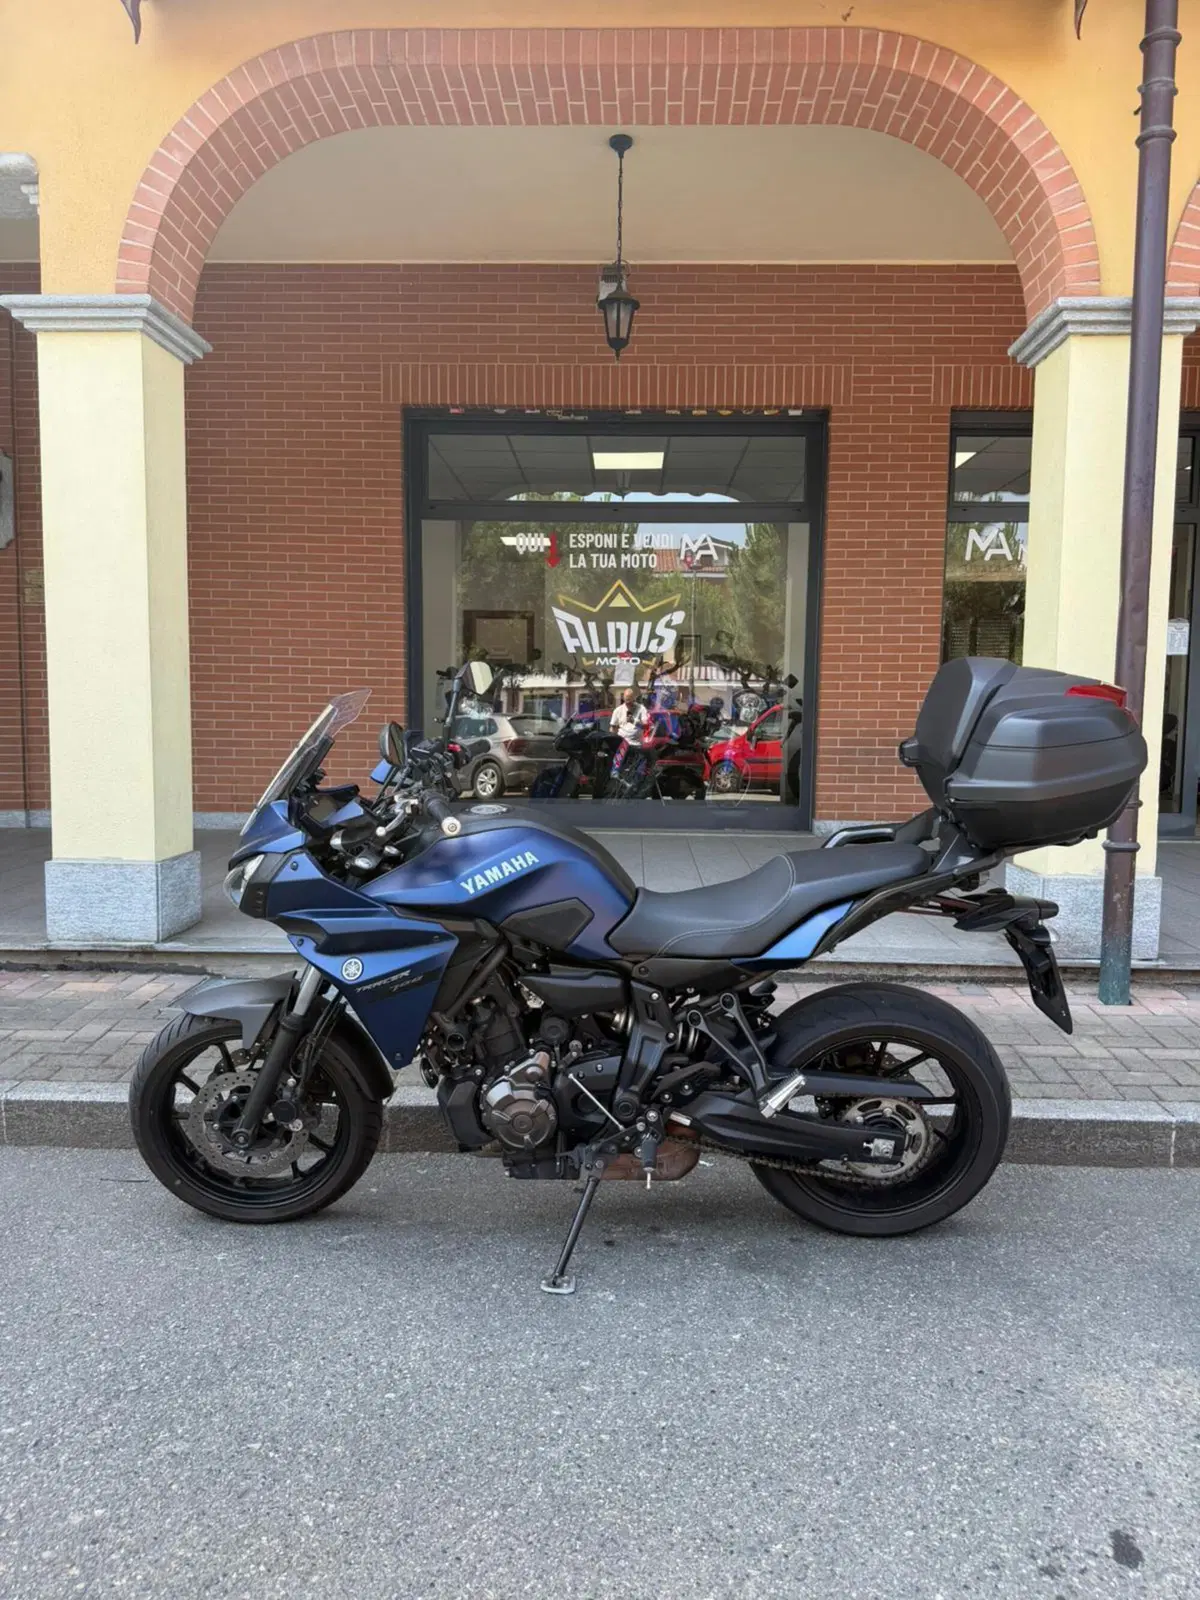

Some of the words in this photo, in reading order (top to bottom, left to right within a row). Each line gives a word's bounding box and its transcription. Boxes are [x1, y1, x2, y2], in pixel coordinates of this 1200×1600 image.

[515, 532, 545, 555] QUI
[569, 533, 618, 549] ESPONI
[621, 533, 630, 549] E
[634, 533, 674, 549] VENDI
[569, 553, 587, 569] LA
[591, 553, 617, 569] TUA
[620, 553, 657, 569] MOTO
[551, 606, 686, 654] ALDUS
[595, 657, 641, 667] MOTO
[460, 851, 539, 895] YAMAHA
